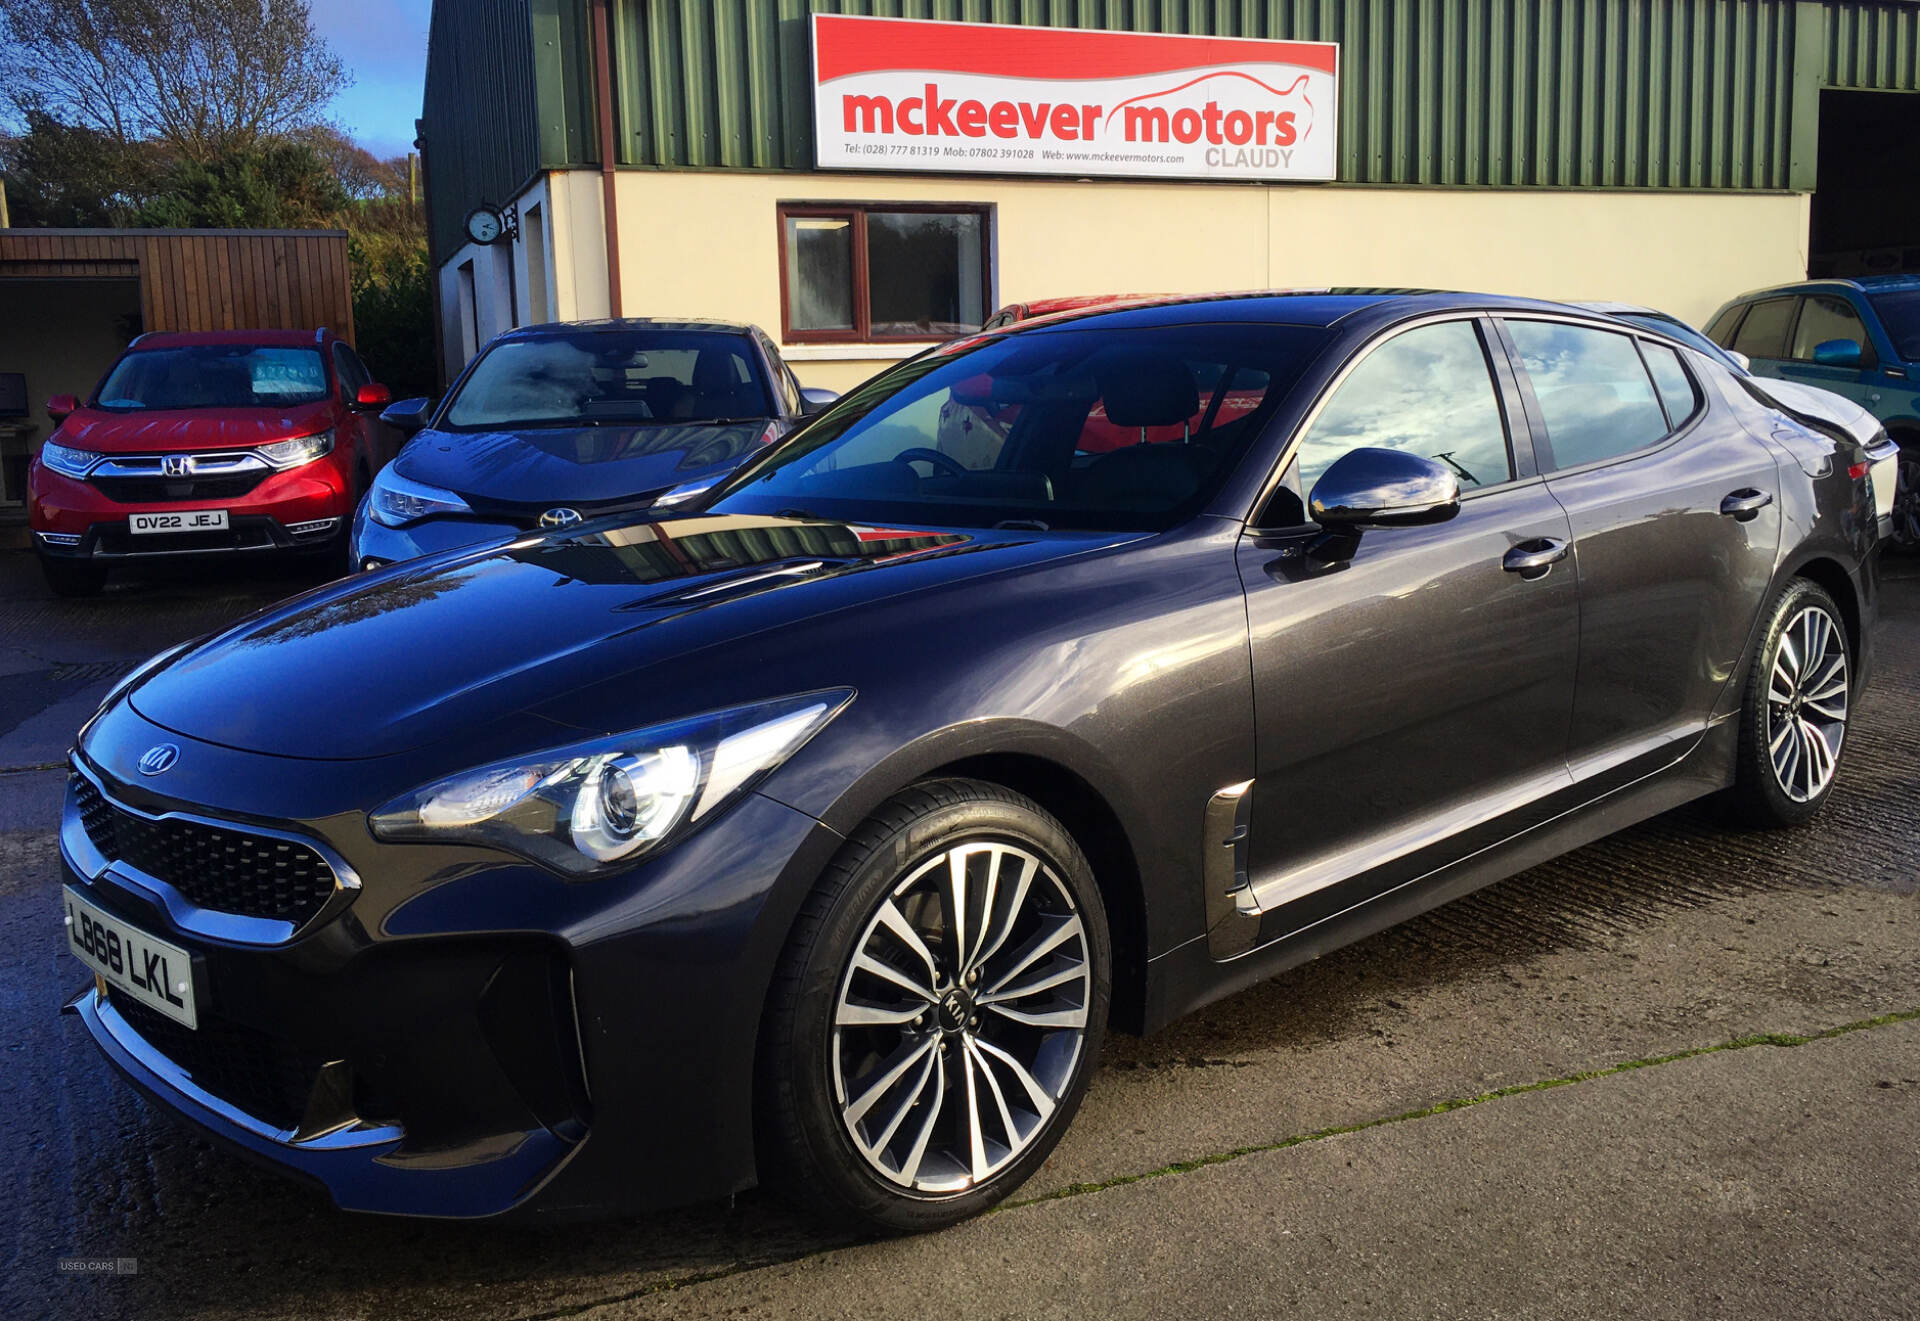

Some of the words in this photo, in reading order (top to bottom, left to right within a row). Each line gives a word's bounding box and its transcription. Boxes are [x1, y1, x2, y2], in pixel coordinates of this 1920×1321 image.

[842, 83, 1103, 141] mckeever
[1124, 101, 1297, 147] motors
[844, 143, 861, 154] Tel:
[863, 145, 888, 156] (028)
[890, 145, 908, 156] 777
[909, 146, 940, 157] 81319
[943, 147, 967, 158] Mob:
[969, 148, 998, 158] 07802
[1000, 149, 1034, 159] 391028
[1042, 150, 1064, 160] Web:
[1066, 152, 1185, 164] www.mckeevermotors.com
[1205, 148, 1294, 169] CLAUDY
[136, 516, 182, 529] OV22
[188, 514, 222, 527] JEJ
[69, 903, 124, 975] LB68
[127, 939, 184, 1009] LKL
